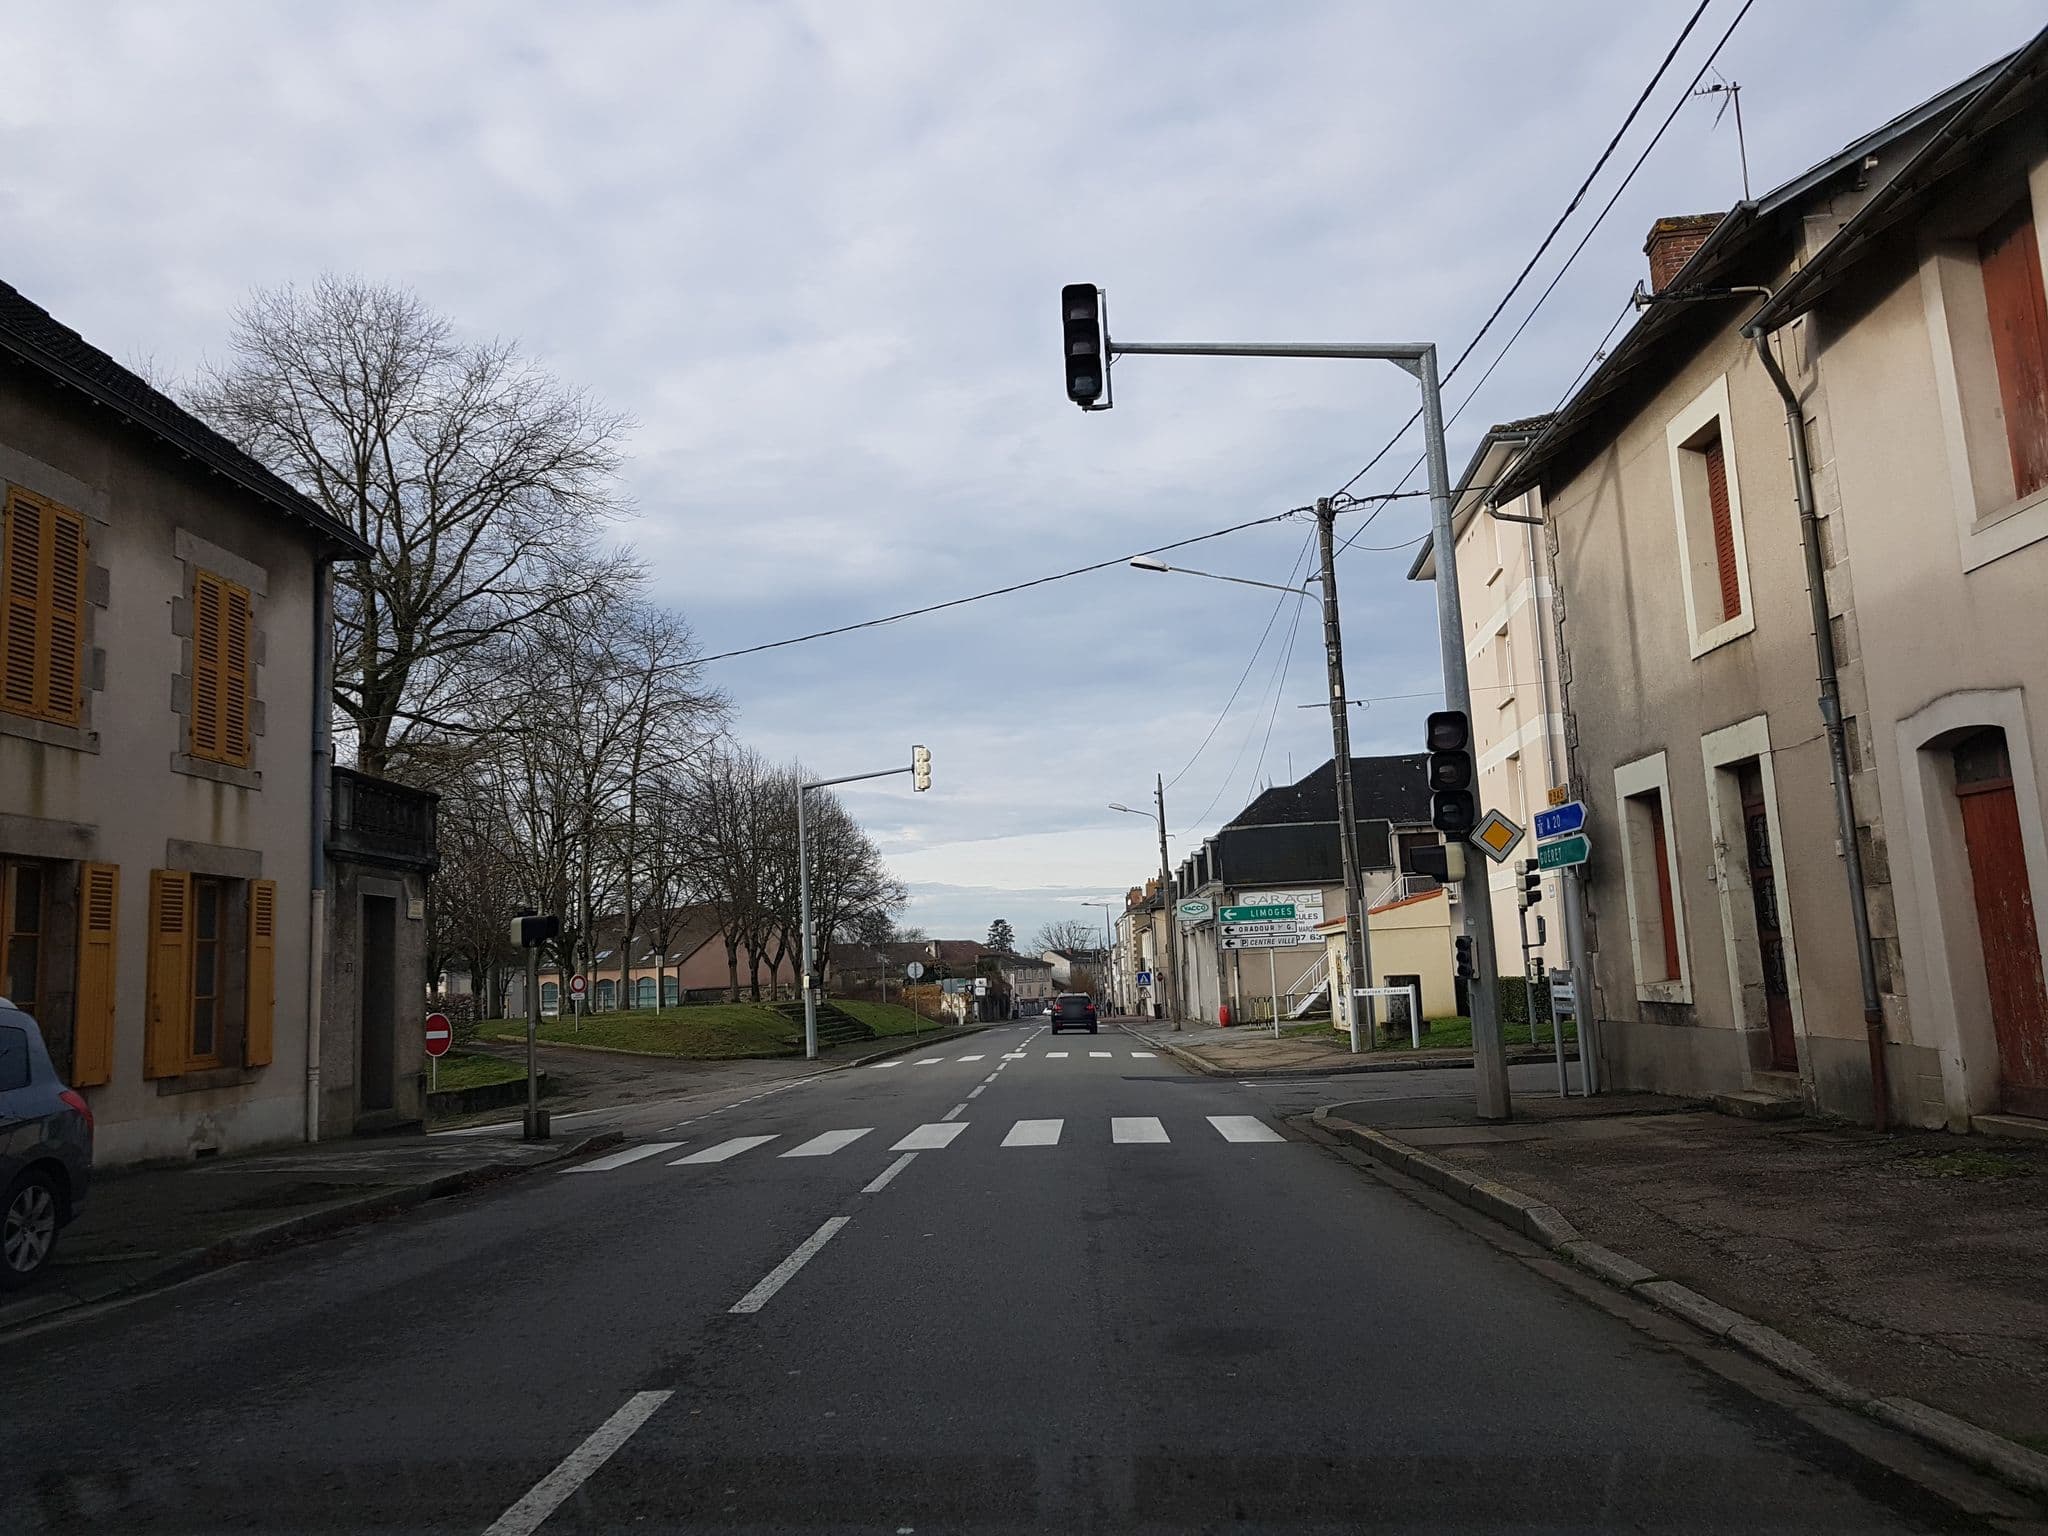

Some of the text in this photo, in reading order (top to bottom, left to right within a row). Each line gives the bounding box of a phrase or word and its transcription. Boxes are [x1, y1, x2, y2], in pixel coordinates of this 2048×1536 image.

[1546, 814, 1561, 830] A 20
[1539, 847, 1562, 865] GUÉRET
[1242, 893, 1321, 906] GARAGE
[1250, 907, 1292, 918] LIMOGES
[1238, 924, 1275, 932] ORADOUR
[1249, 937, 1295, 946] CENTRE VILLE
